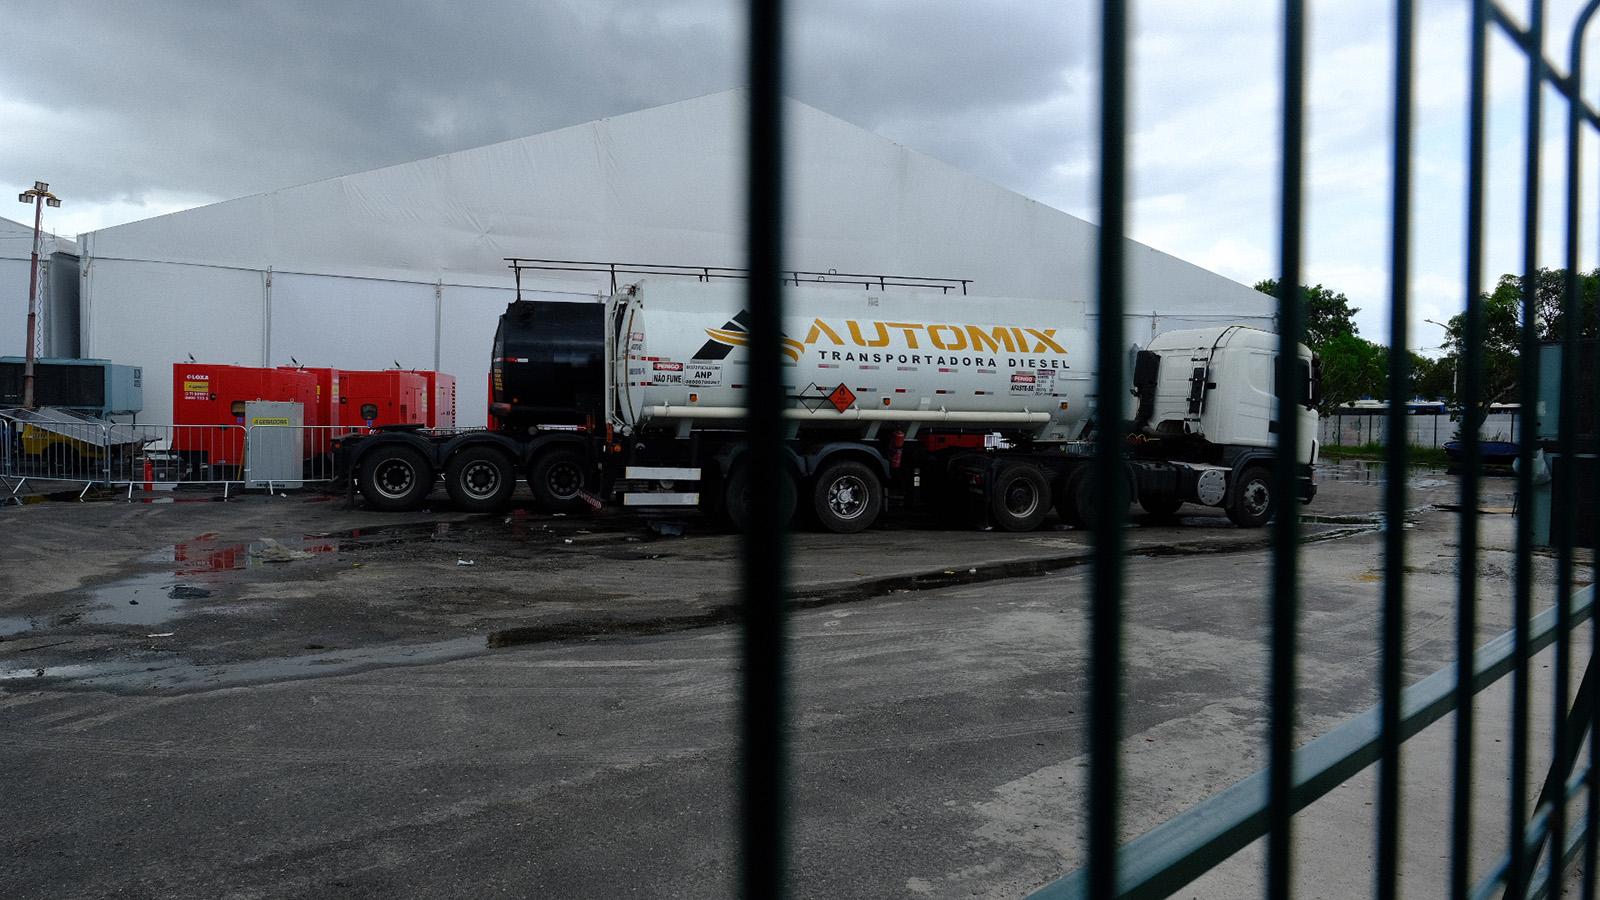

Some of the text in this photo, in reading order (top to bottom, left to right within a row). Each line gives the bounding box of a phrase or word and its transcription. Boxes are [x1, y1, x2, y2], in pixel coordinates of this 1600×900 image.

[804, 318, 1069, 355] AUTOMIX
[818, 350, 1070, 370] TRANSPORTADORA DIESEL
[653, 373, 682, 383] NÃO FUME
[694, 371, 713, 379] ANP
